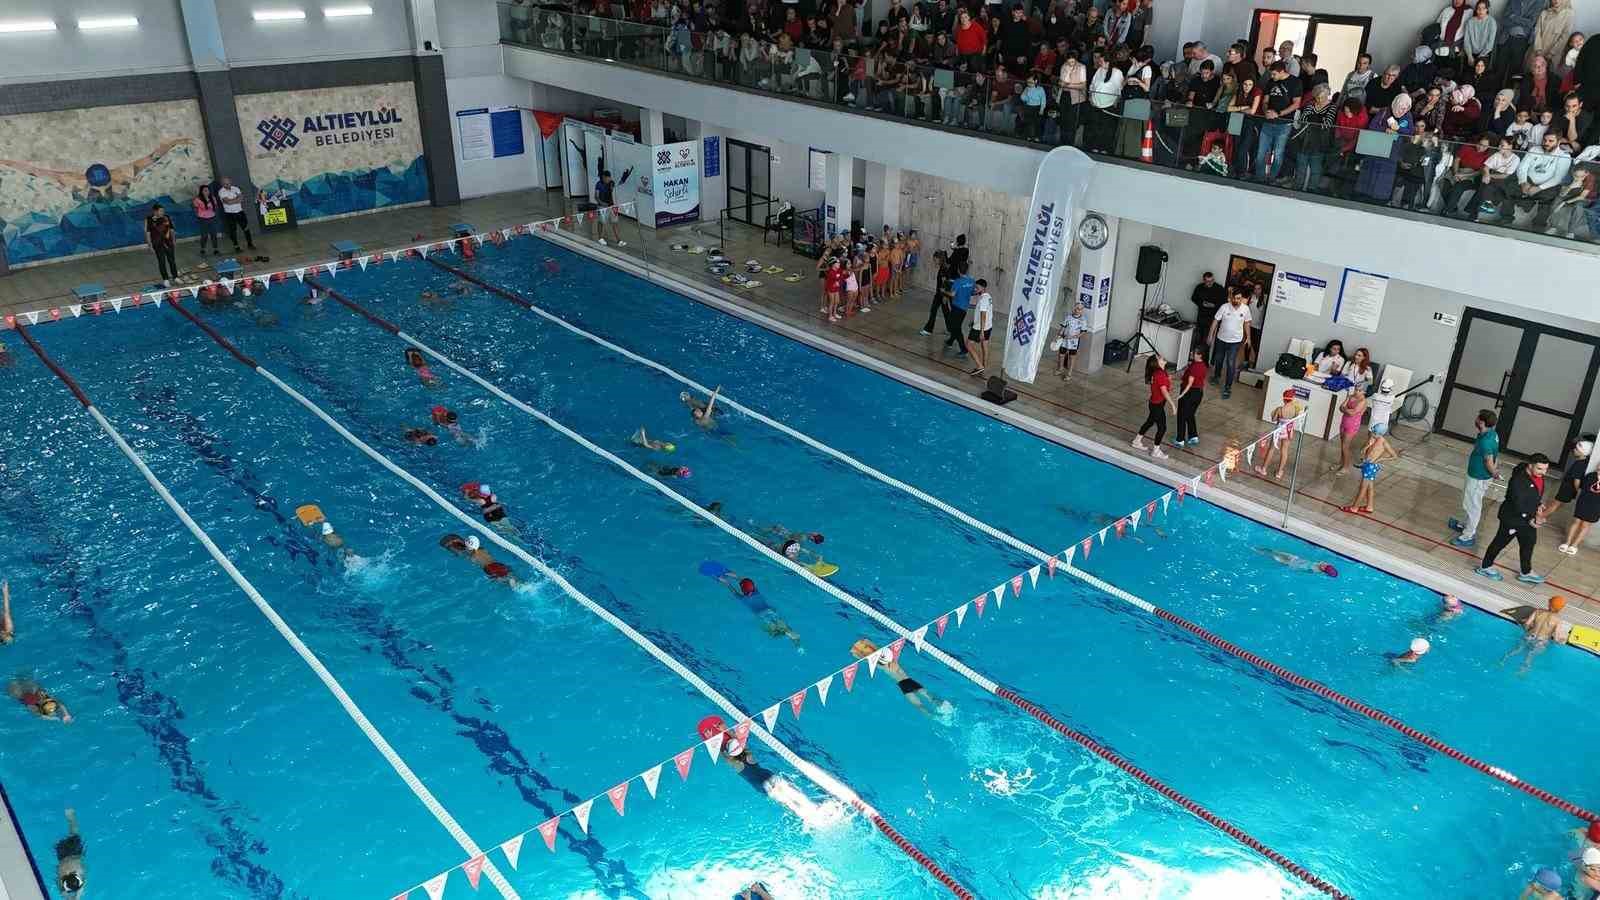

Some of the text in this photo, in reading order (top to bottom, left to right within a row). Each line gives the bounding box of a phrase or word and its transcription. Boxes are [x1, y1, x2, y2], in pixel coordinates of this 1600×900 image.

[303, 107, 402, 133] ALTIEYLÜL
[315, 128, 394, 147] BELEDİYESİ
[663, 177, 689, 187] HAKAN
[1022, 202, 1054, 301] ALTIEYLÜL
